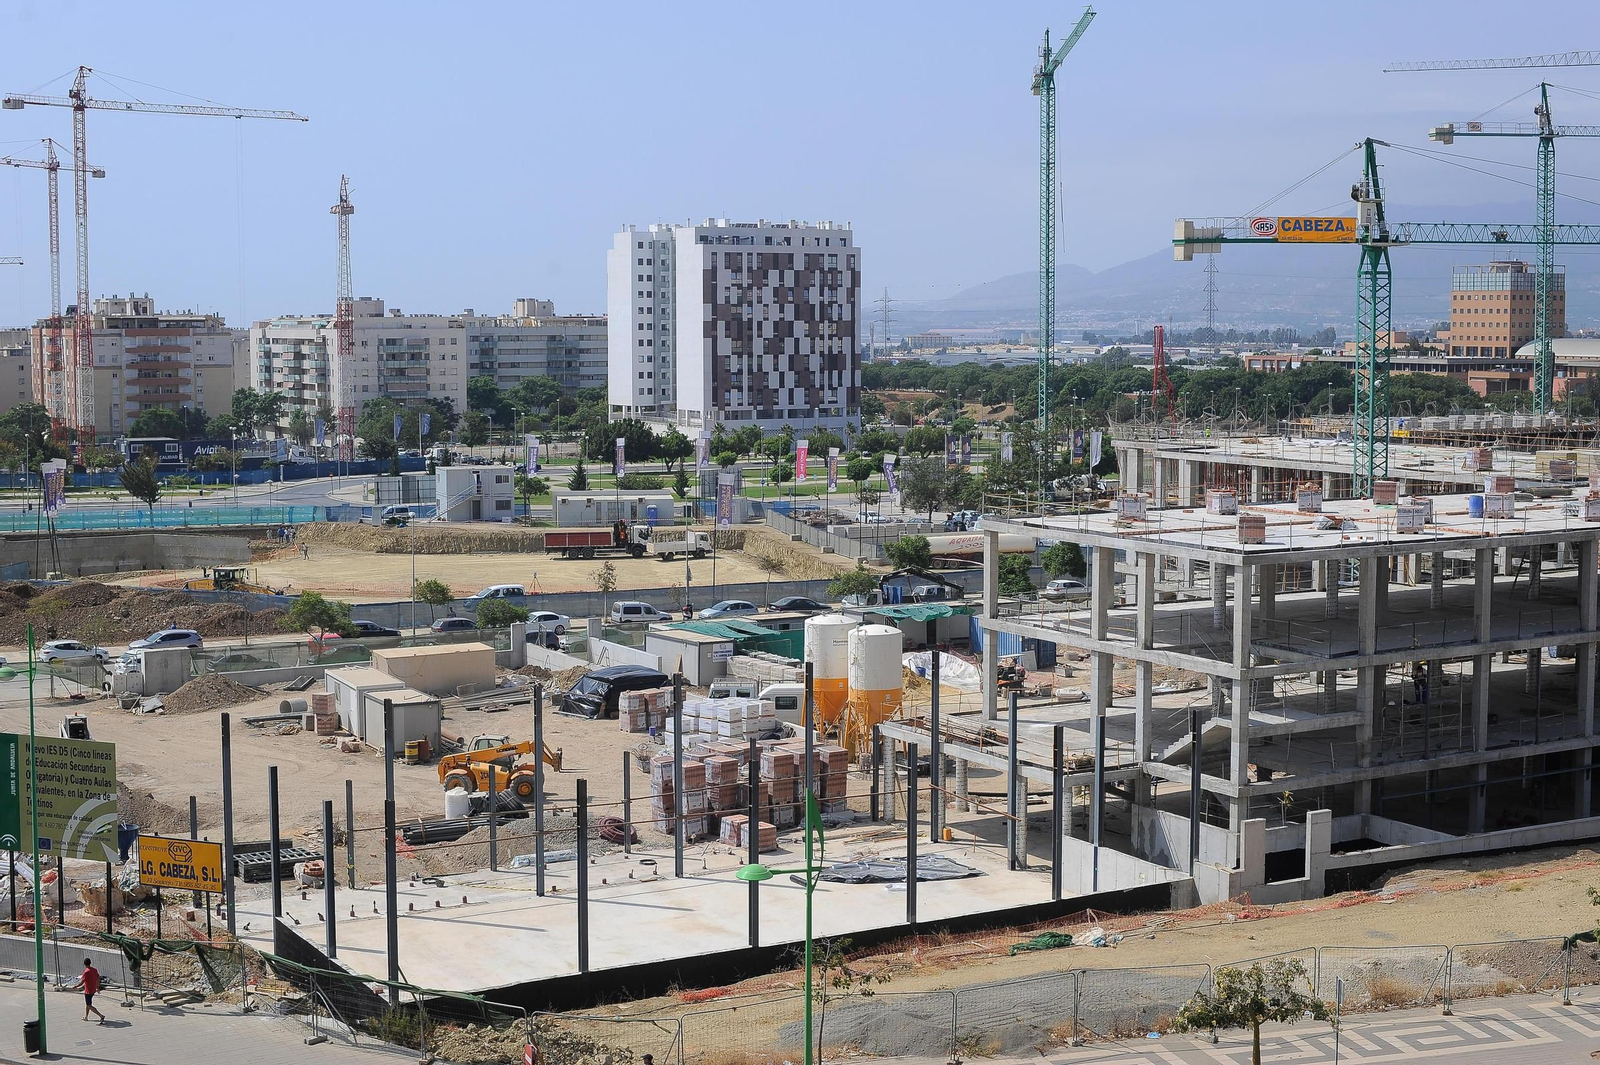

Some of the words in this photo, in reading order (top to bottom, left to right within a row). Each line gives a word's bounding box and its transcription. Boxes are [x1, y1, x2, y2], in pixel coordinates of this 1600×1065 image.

[1280, 220, 1345, 232] CABEZA
[26, 743, 45, 754] Nevo
[46, 745, 58, 755] IES
[60, 746, 68, 756] D5
[70, 747, 91, 758] (Cinco
[36, 758, 68, 770] Educación
[70, 761, 106, 774] Secundaria
[26, 770, 64, 784] Oigatoria)
[65, 776, 70, 785] y
[70, 774, 92, 786] Cuatro
[94, 777, 112, 788] Aulas
[26, 783, 66, 798] Pivalentes,
[78, 788, 84, 798] la
[85, 790, 100, 800] Zona
[102, 791, 111, 800] de
[26, 796, 53, 808] Tetinos
[172, 845, 188, 853] GVC
[141, 860, 156, 875] LG.
[160, 862, 198, 882] CABEZA,
[202, 866, 220, 882] S.L.
